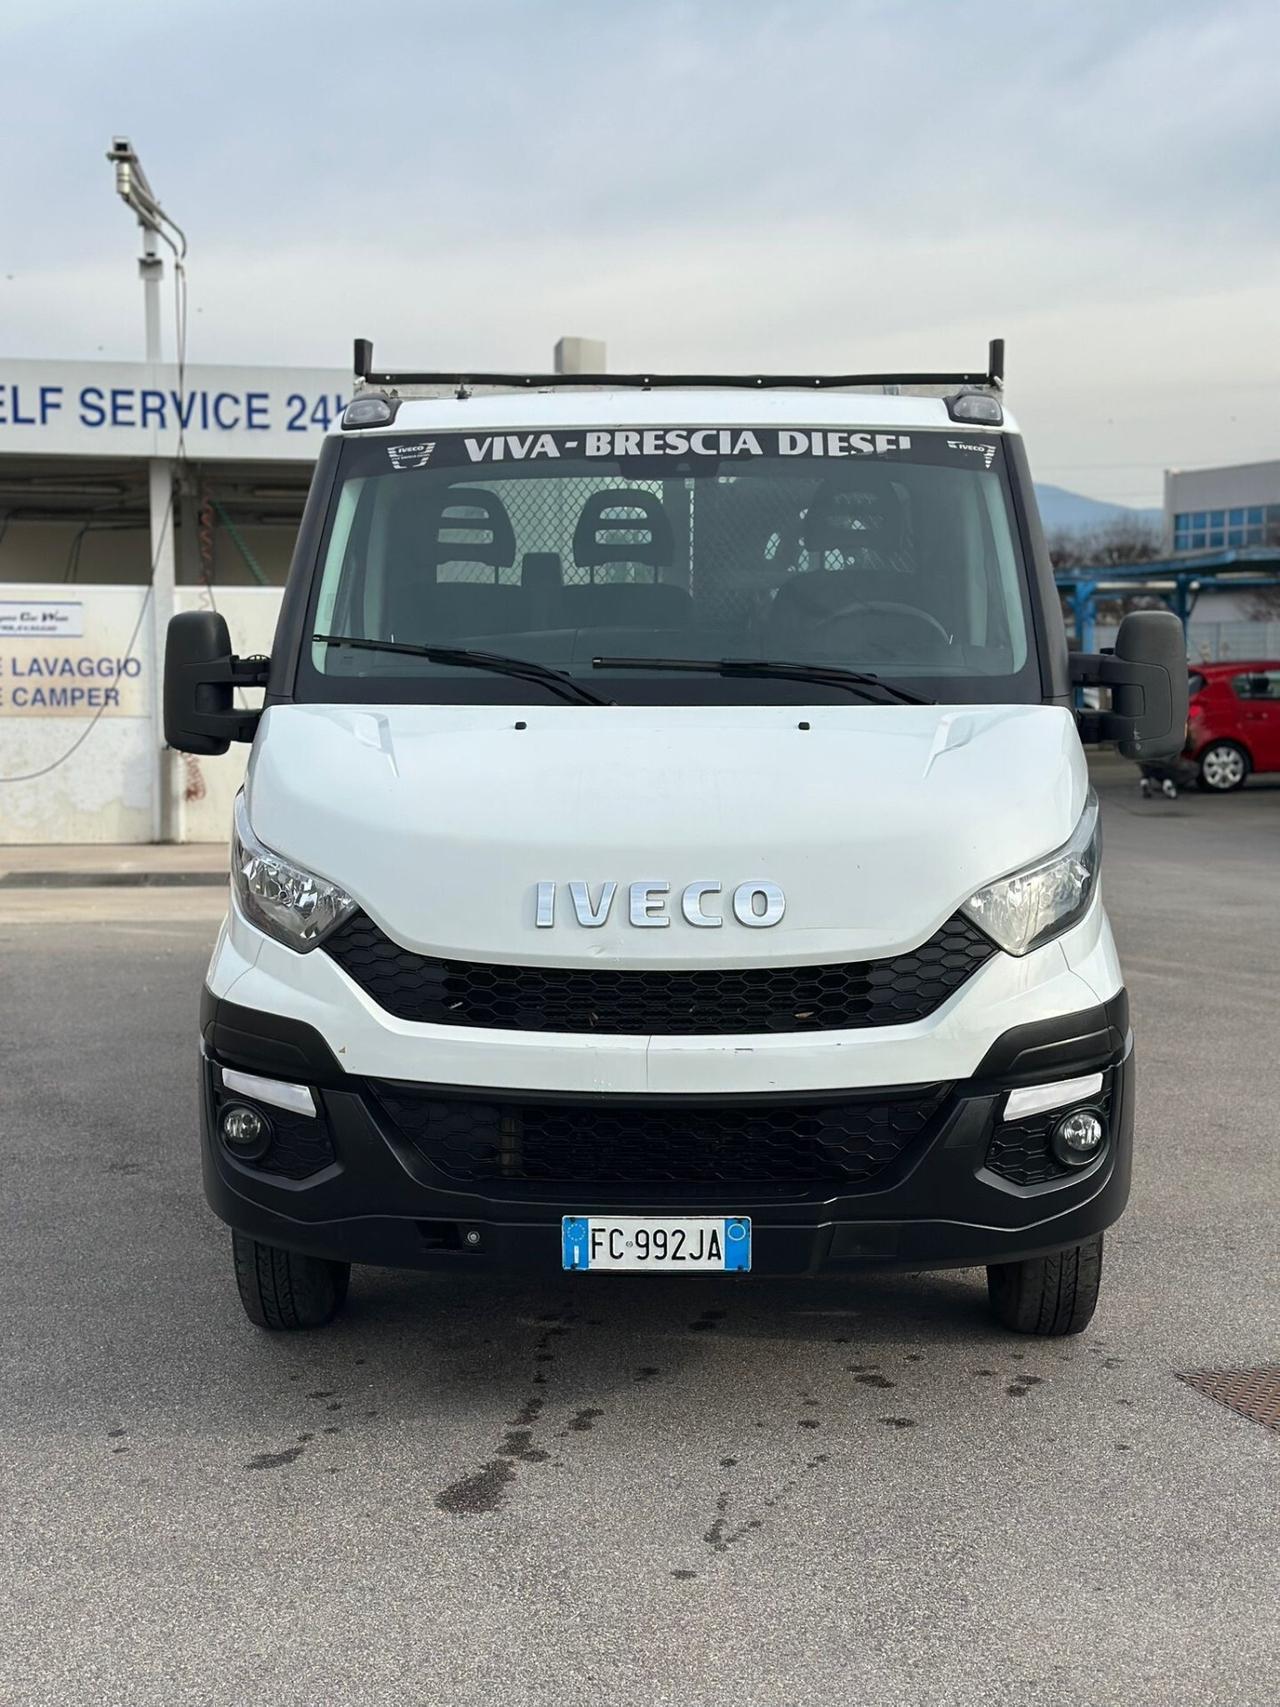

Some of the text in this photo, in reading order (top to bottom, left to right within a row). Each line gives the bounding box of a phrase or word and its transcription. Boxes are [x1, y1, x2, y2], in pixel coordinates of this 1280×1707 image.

[0, 384, 63, 425] LF
[79, 386, 271, 431] SERVICE
[398, 445, 424, 453] IVECO
[959, 444, 985, 452] IVECO
[11, 656, 141, 677] LAVAGGIO
[11, 687, 120, 707] CAMPER
[535, 880, 786, 929] IVECO
